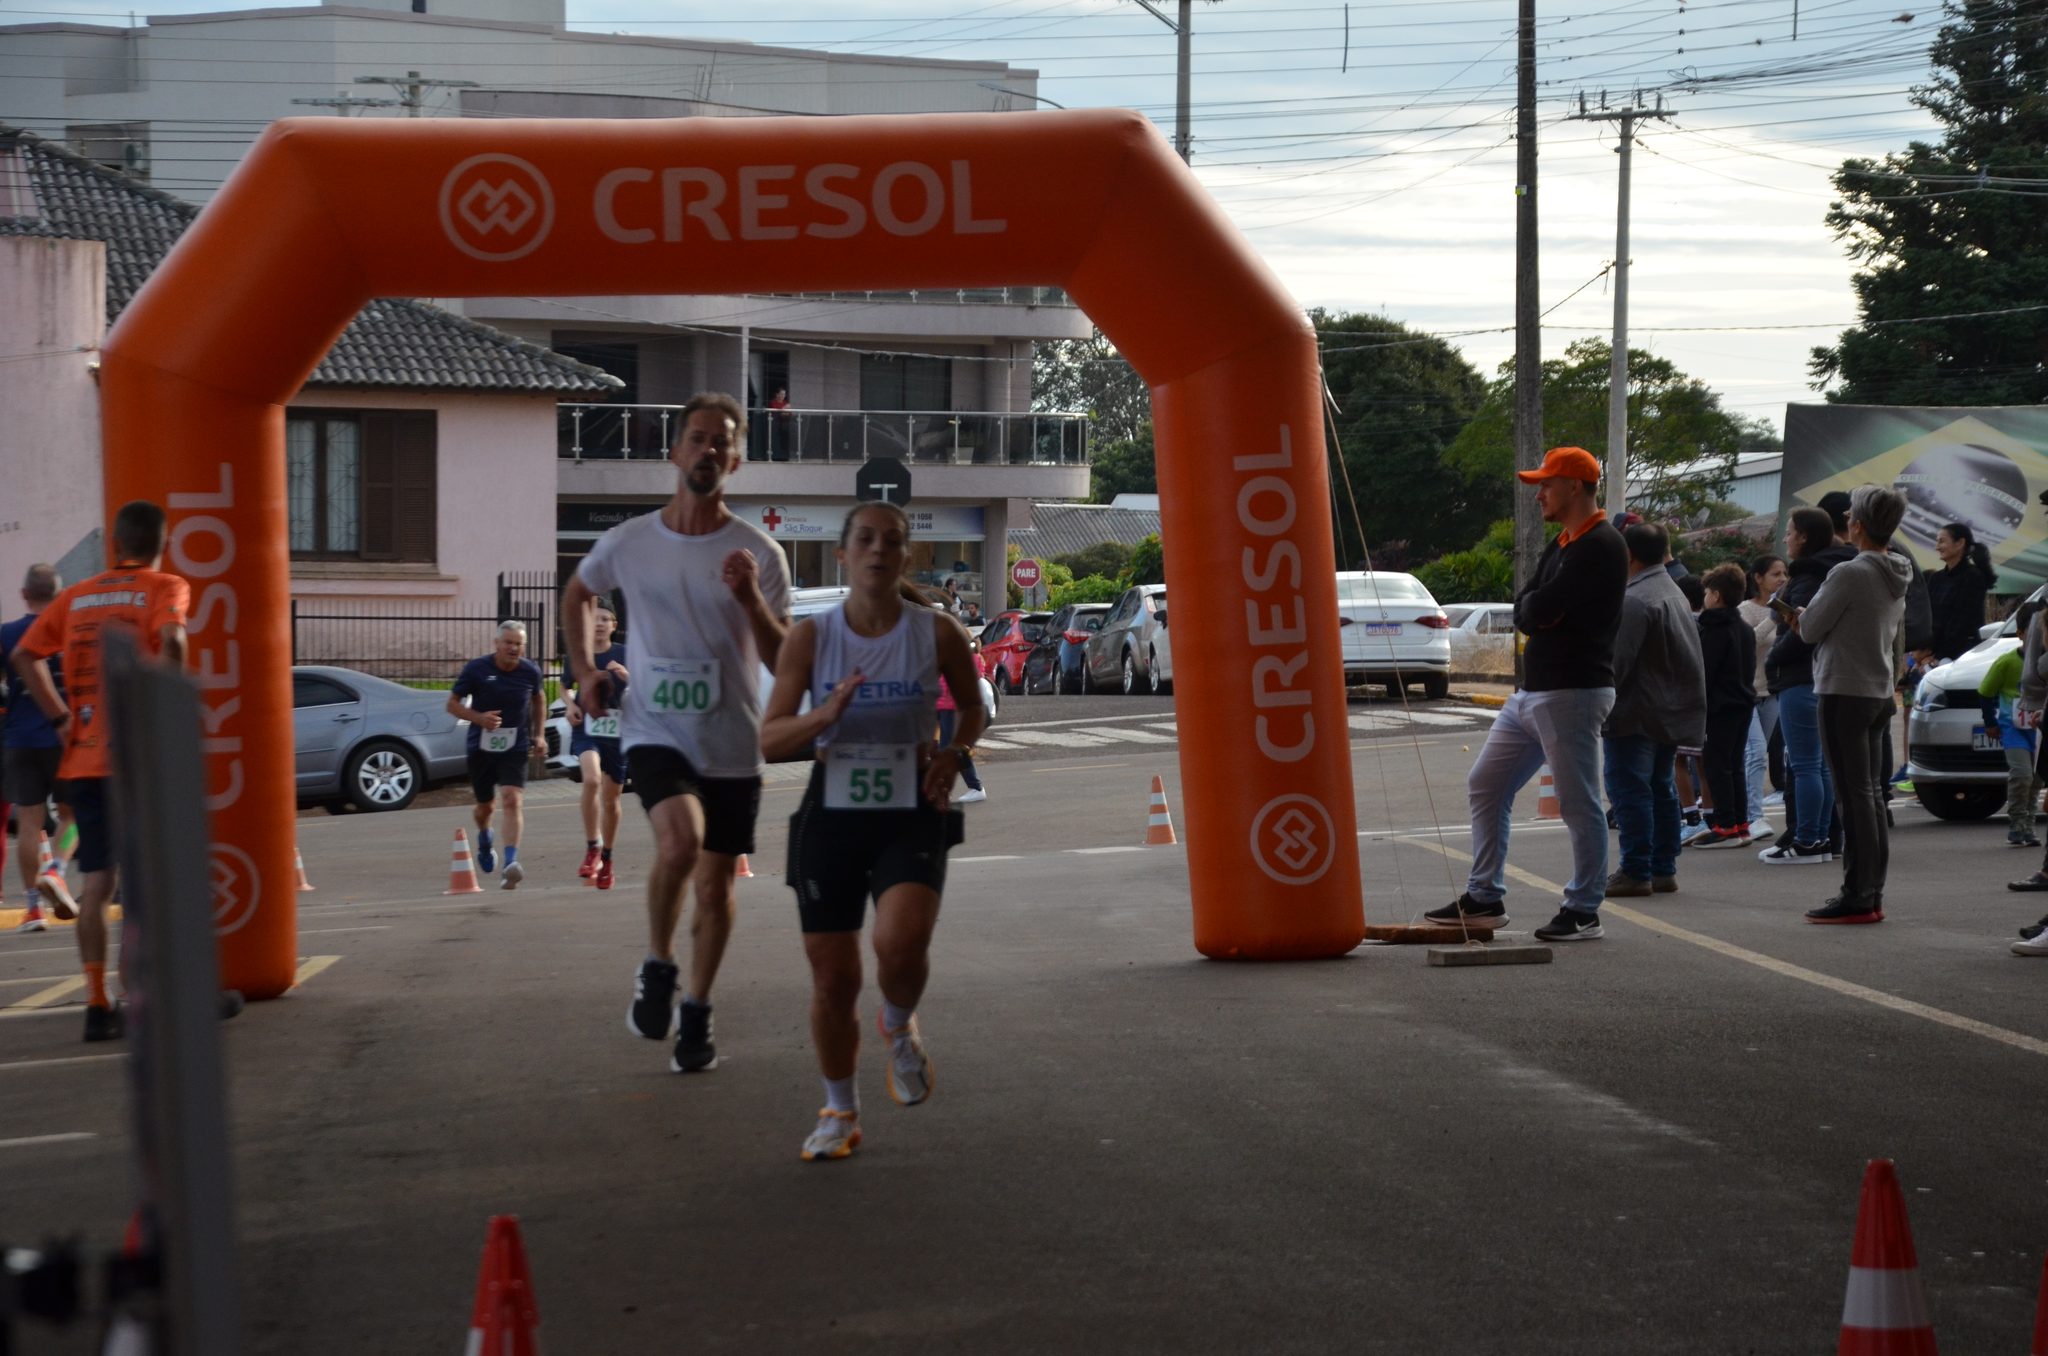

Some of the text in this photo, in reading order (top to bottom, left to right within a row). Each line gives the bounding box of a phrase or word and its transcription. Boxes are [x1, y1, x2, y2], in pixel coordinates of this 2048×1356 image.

[593, 159, 1008, 244] CRESOL
[1016, 568, 1037, 578] PARE
[1233, 423, 1316, 763] CRESOL
[653, 680, 710, 711] 400
[591, 718, 617, 734] 212
[490, 737, 508, 749] 90
[850, 768, 893, 803] 55
